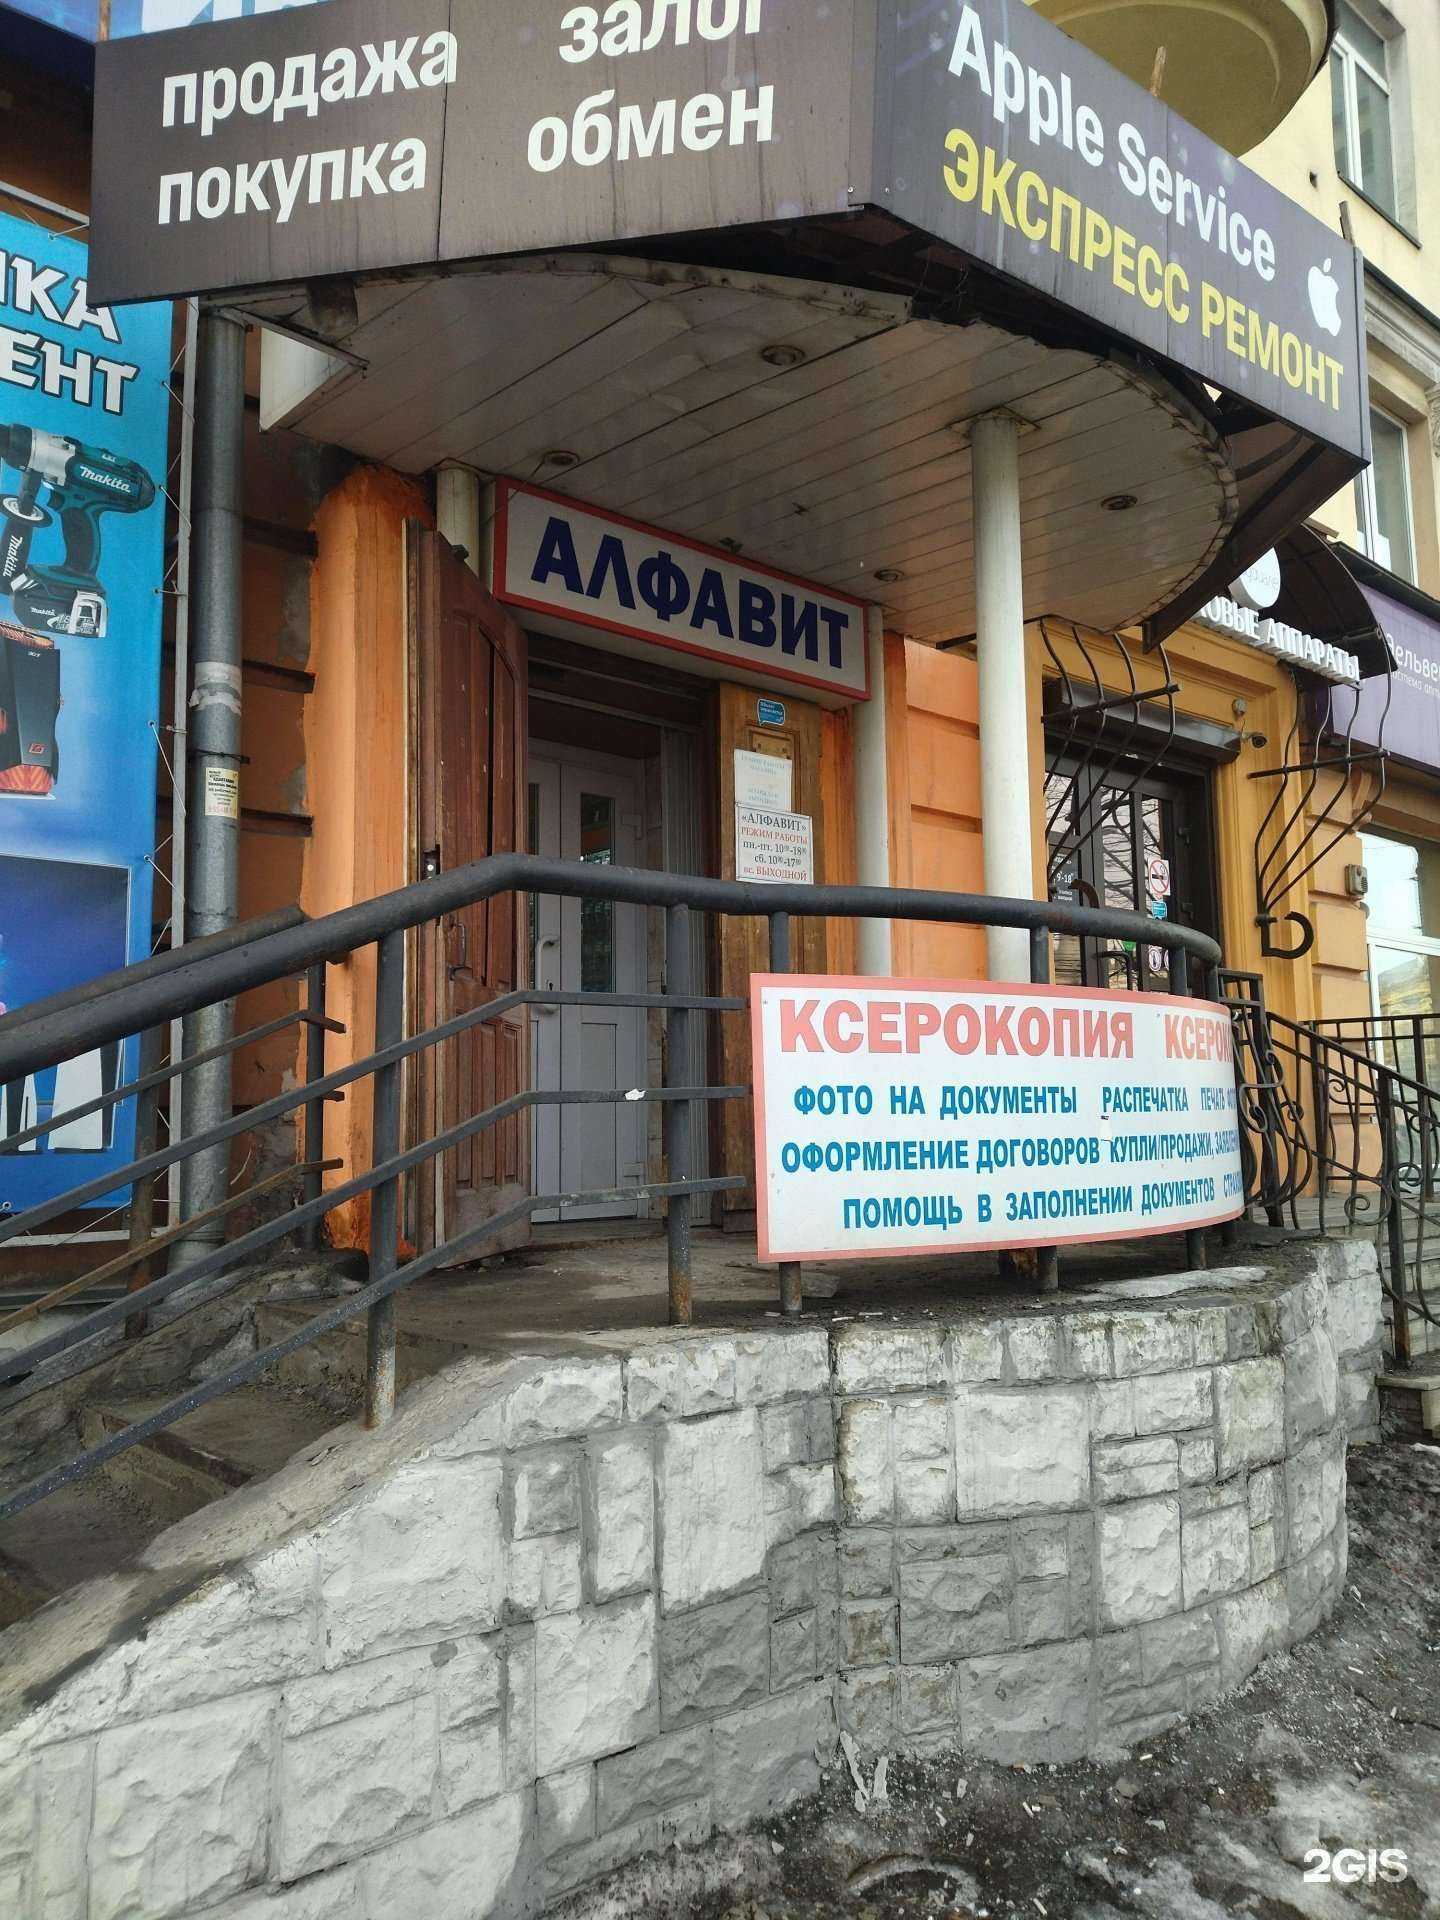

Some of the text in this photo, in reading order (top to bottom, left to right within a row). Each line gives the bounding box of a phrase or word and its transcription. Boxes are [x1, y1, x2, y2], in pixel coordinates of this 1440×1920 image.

[161, 30, 458, 136] продажа
[527, 85, 774, 173] обмен
[947, 4, 1276, 282] Apple Service
[158, 137, 427, 225] покупка
[0, 249, 121, 344] КА
[942, 128, 1344, 411] ЭКСПРЕСС РЕМОНТ
[530, 516, 849, 669] АЛФАВИТ
[1200, 595, 1360, 684] ОВЫЕ АППАРАТЫ
[741, 812, 807, 832] «АЛФАВИТ»
[741, 826, 808, 845] РЕЖИМ РАБОТЫ
[756, 866, 808, 881] ВЫХОДНОЙ
[780, 998, 1134, 1059] КСЕРОКОПИЯ
[793, 1085, 873, 1115] ФОТО
[889, 1085, 926, 1115] НА
[940, 1085, 1078, 1120] ДОКУМЕНТЫ
[1102, 1086, 1189, 1113] РАСПЕЧАТКА
[781, 1139, 969, 1173] ОФОРМЛЕНИЕ
[976, 1136, 1100, 1174] ДОГОВОРОВ
[843, 1195, 963, 1231] ПОМОЩЬ
[977, 1194, 992, 1223] В
[1005, 1186, 1133, 1222] ЗАПОЛНЕНИИ
[1141, 1177, 1215, 1216] ДОКУМЕНТОВ
